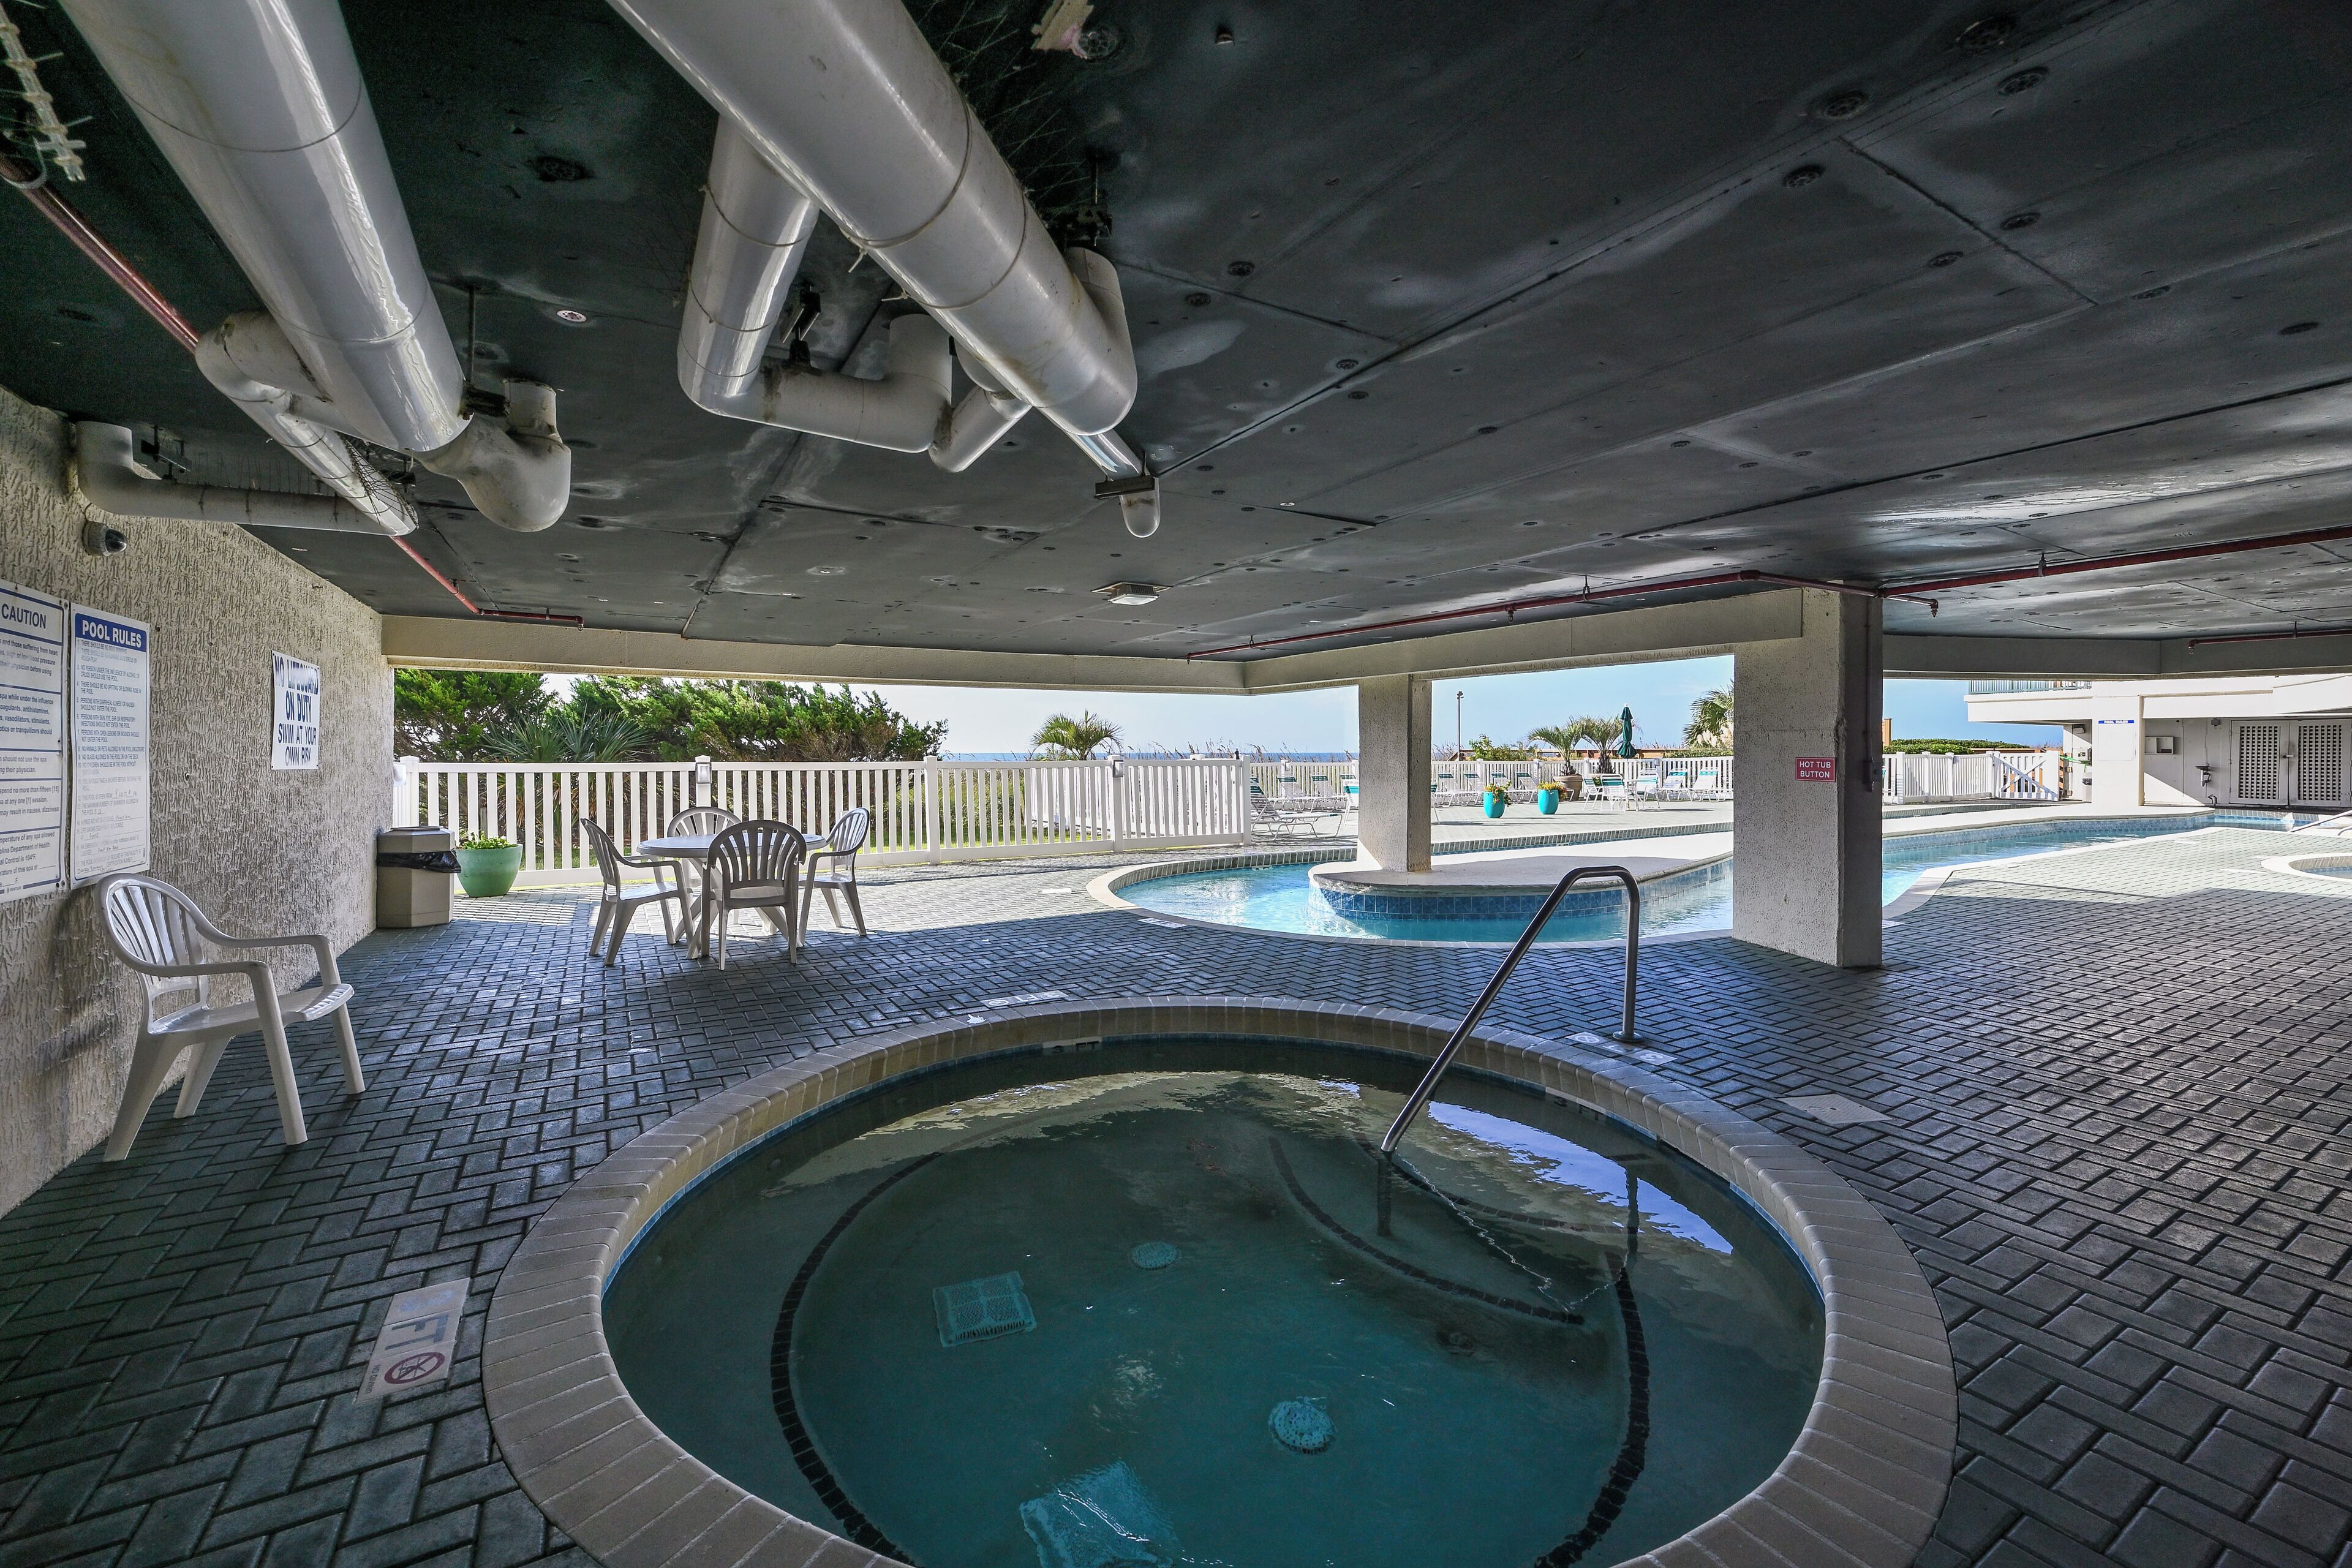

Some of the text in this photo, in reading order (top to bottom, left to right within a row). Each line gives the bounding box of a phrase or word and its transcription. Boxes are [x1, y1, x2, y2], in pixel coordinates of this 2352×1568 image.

[2, 603, 47, 629] CAUTION
[83, 620, 141, 648] POOL RULES
[23, 644, 39, 653] suffering
[274, 655, 318, 695] NO LIFEGUARD
[285, 691, 312, 723] ON DUTY
[278, 723, 316, 745] SWIM AT YOUR
[285, 746, 311, 766] OWN RISK
[385, 1313, 449, 1350] FT
